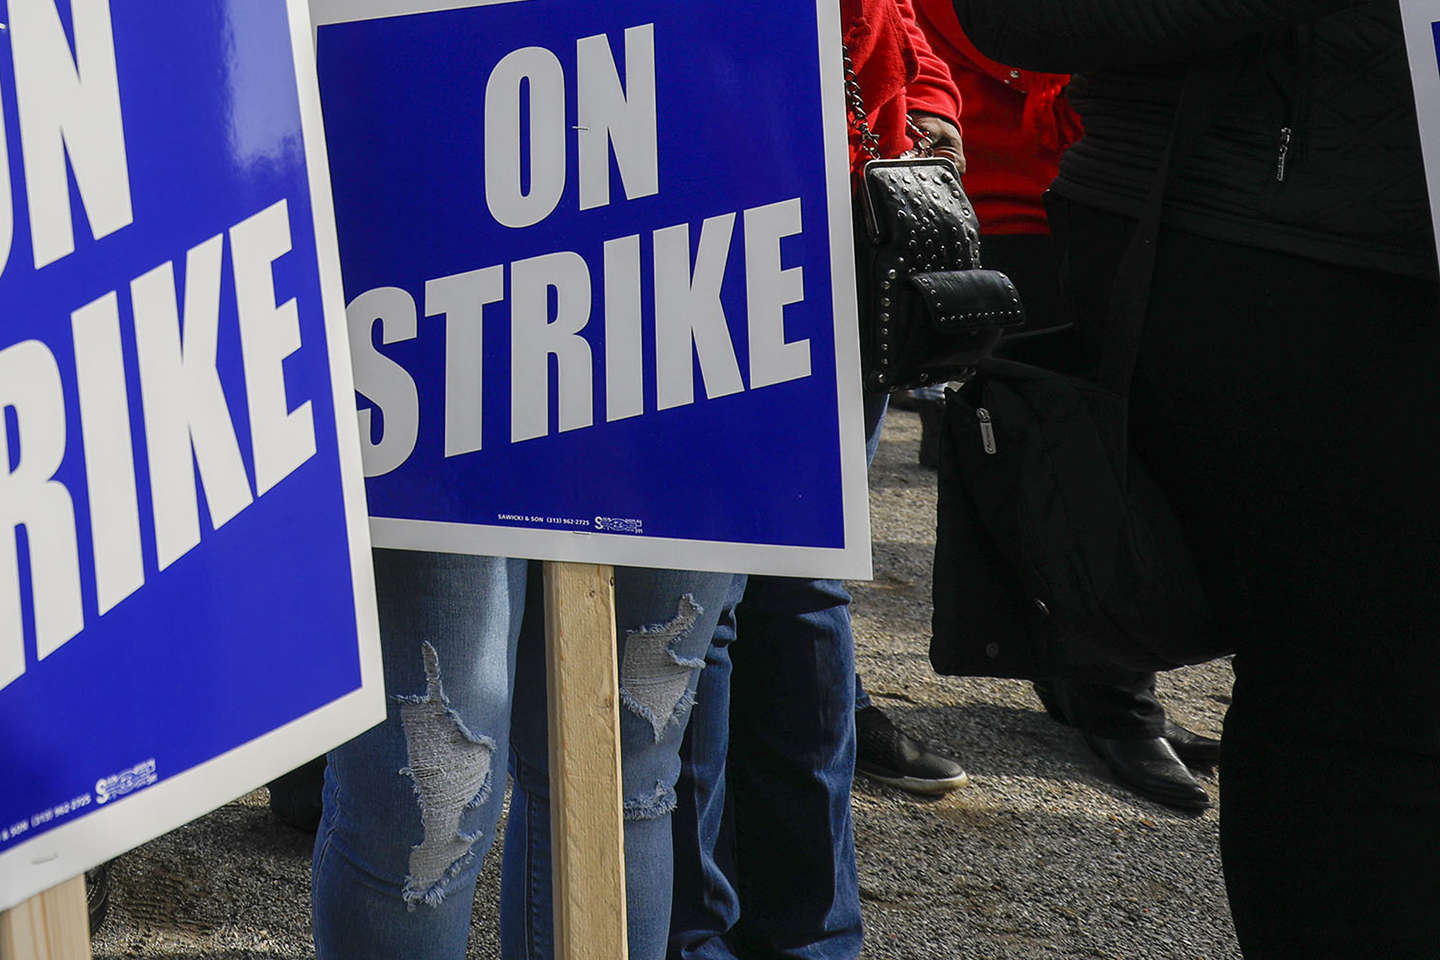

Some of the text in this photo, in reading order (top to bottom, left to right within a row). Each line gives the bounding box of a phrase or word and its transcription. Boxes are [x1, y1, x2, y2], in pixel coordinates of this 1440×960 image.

[484, 22, 659, 228] ON
[346, 196, 812, 478] STRIKE
[497, 513, 524, 521] SAWICKI
[530, 515, 544, 523] SON
[546, 516, 562, 524] (313)
